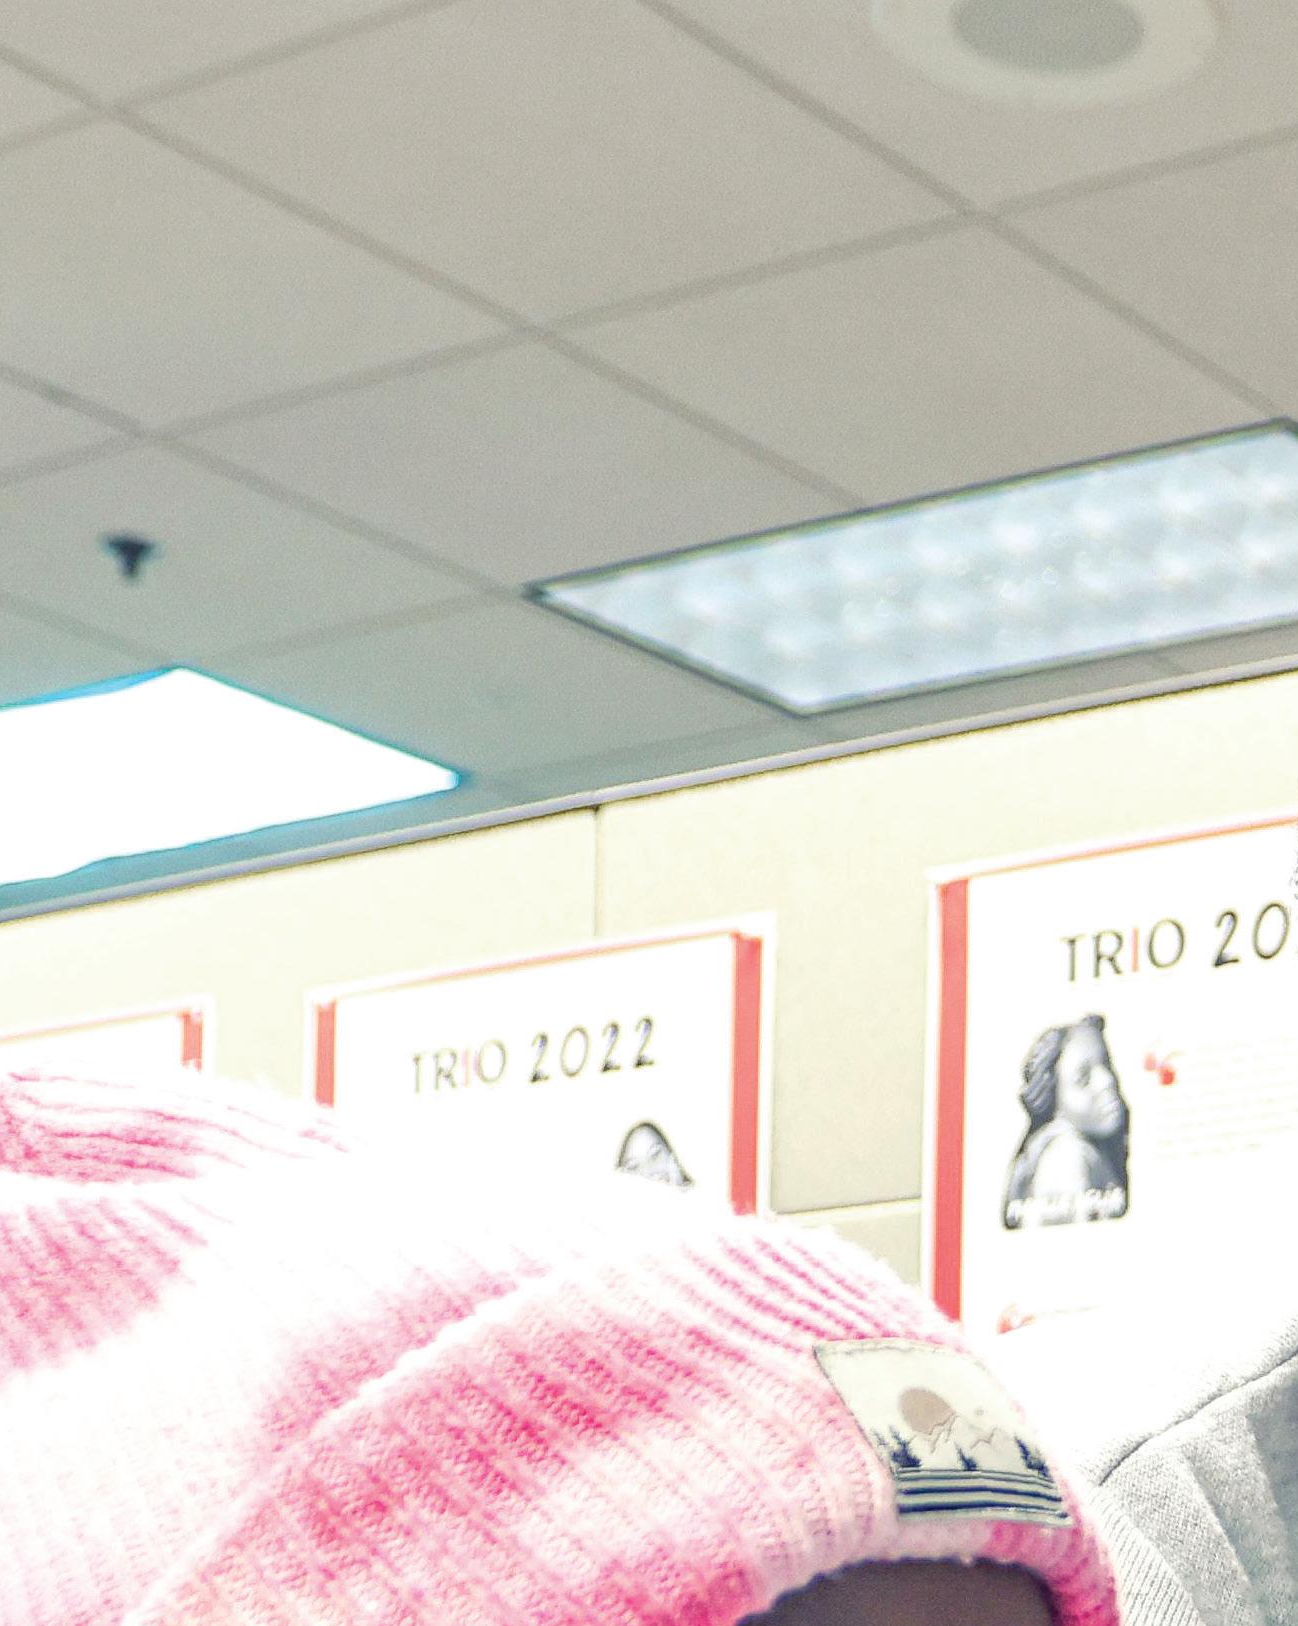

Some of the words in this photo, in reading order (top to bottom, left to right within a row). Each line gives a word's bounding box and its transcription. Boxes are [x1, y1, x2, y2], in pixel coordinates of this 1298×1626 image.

[1061, 918, 1186, 982] TRIO
[1212, 901, 1293, 968] 20
[411, 1039, 508, 1093] TRIO
[528, 1015, 656, 1084] 2022
